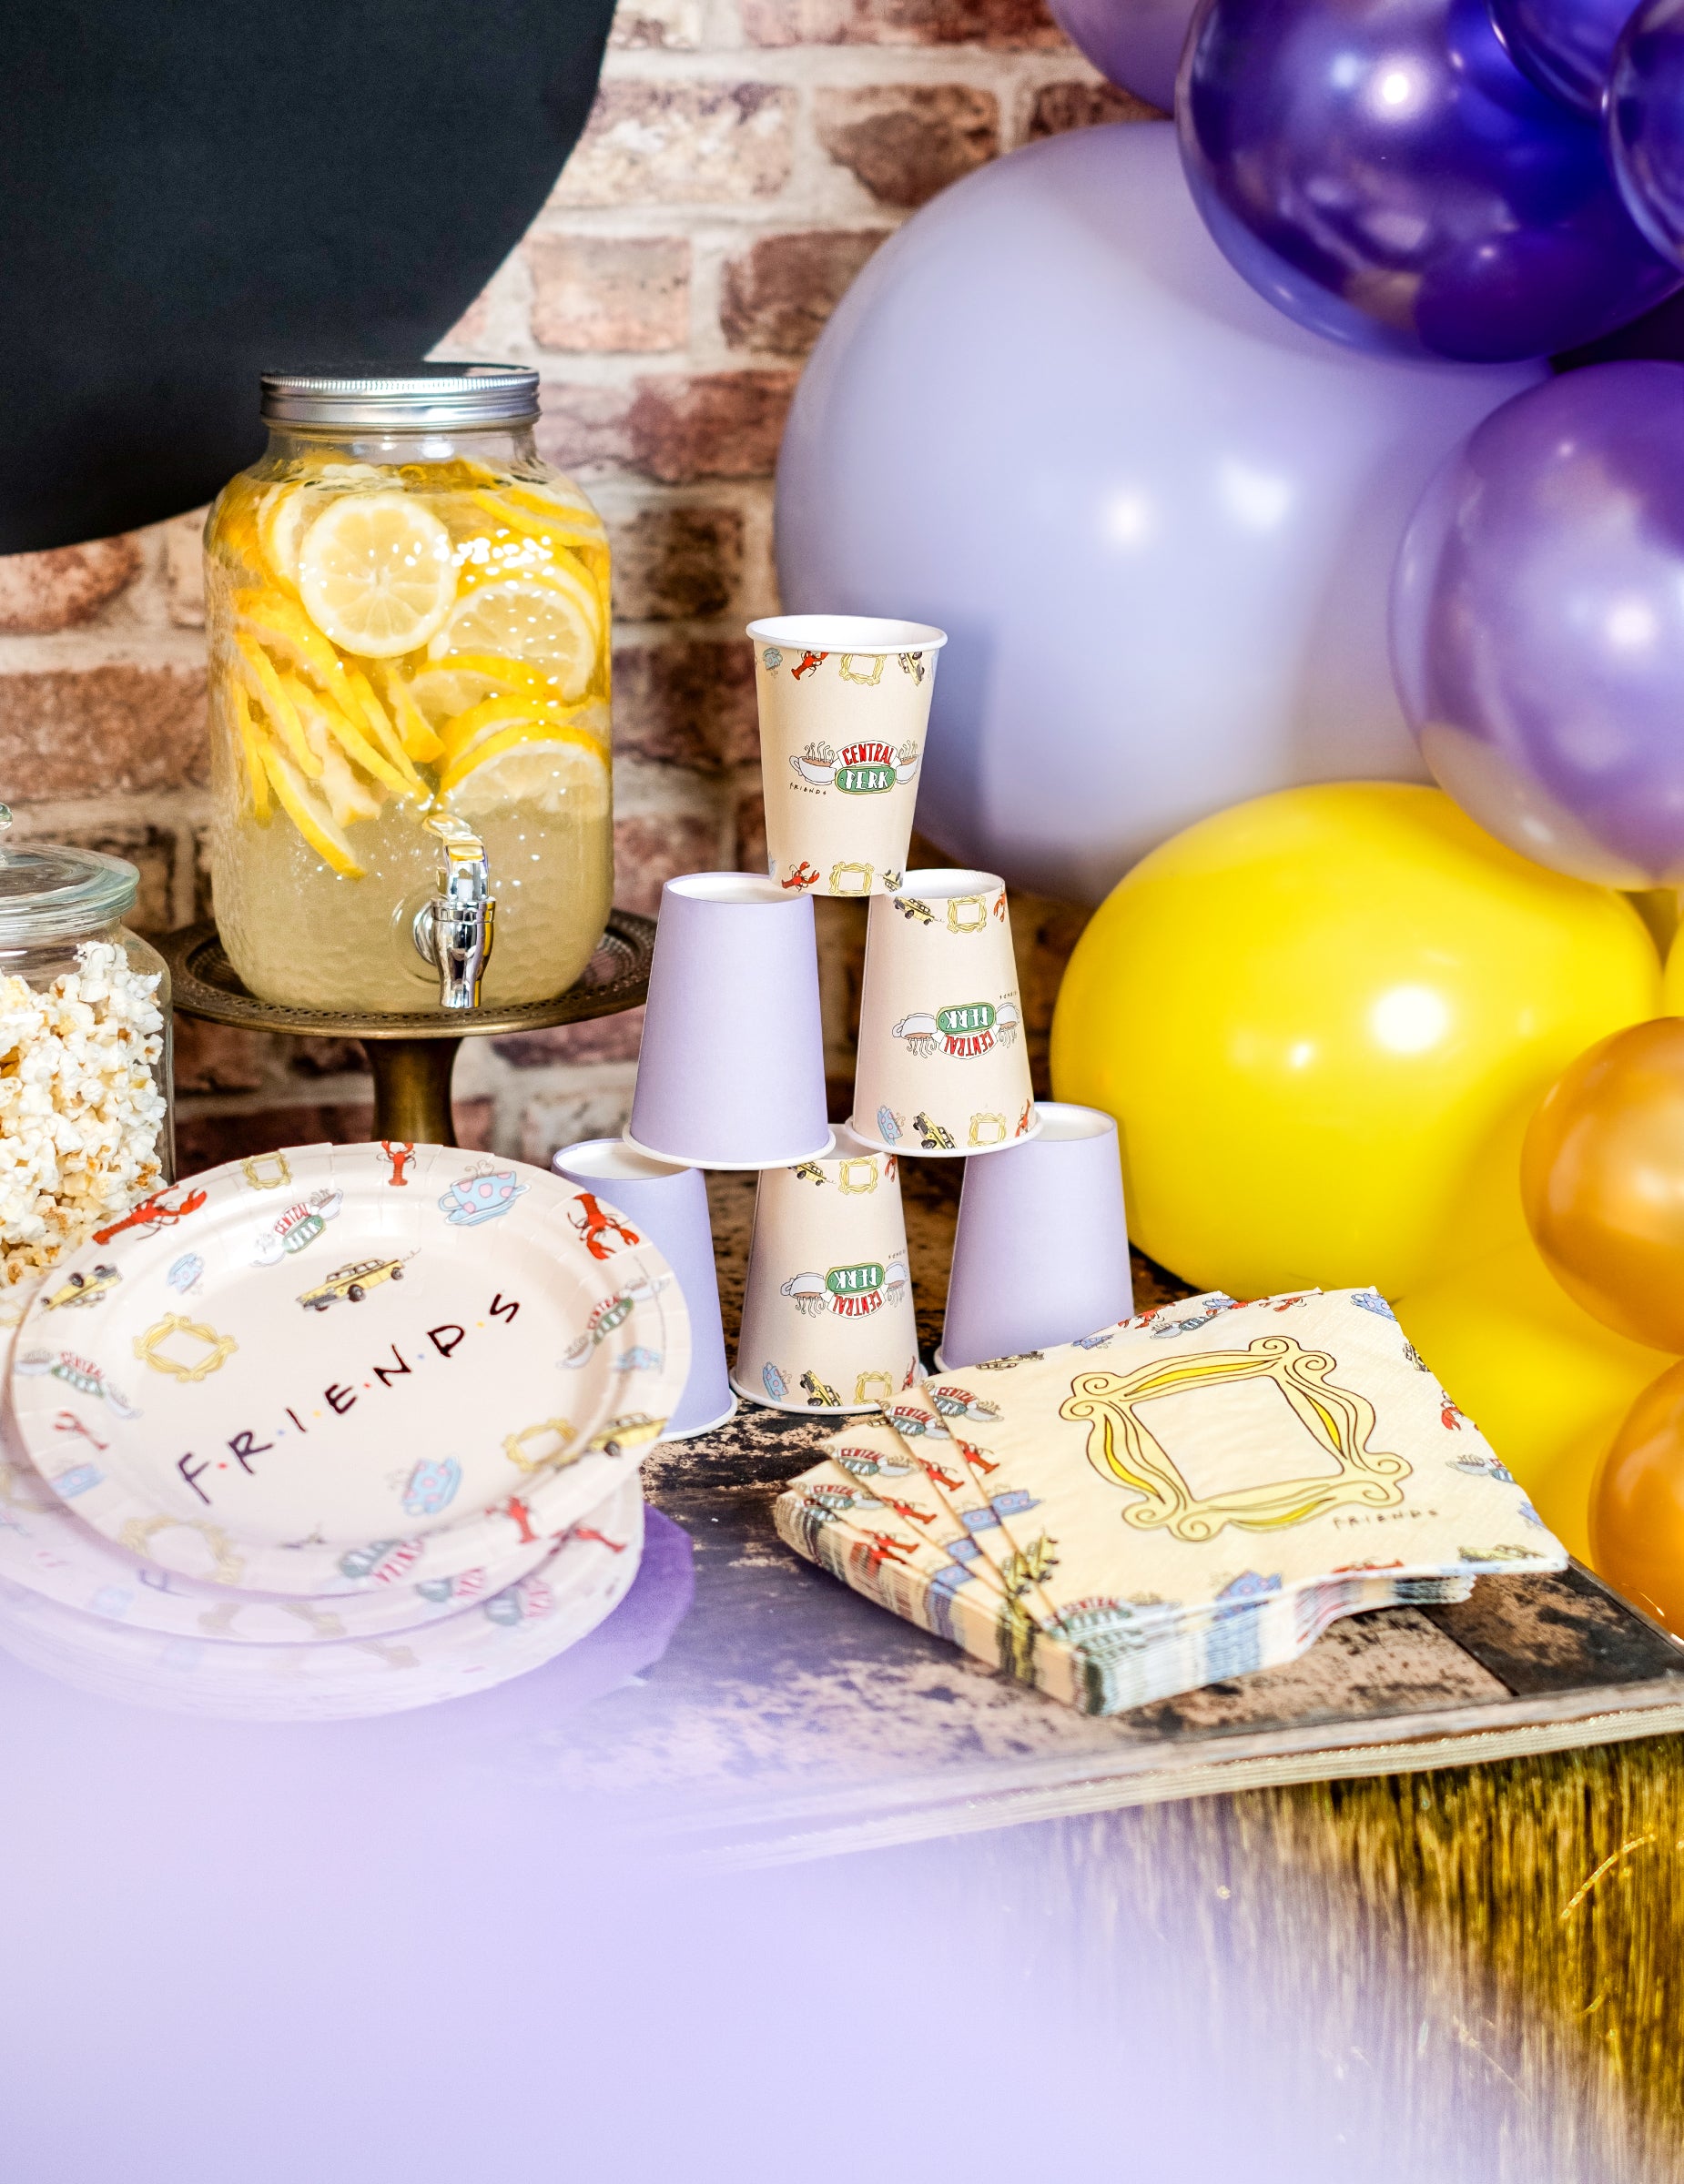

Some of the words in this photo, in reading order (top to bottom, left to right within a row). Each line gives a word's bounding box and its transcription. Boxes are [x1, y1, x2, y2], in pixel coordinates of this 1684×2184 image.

[842, 743, 894, 766] CENTRAL
[845, 769, 889, 790] PERK
[944, 1006, 989, 1029] PERK
[943, 1030, 995, 1057] CENTRAL
[834, 1267, 878, 1289] PERK
[832, 1289, 883, 1317] CENTRAL
